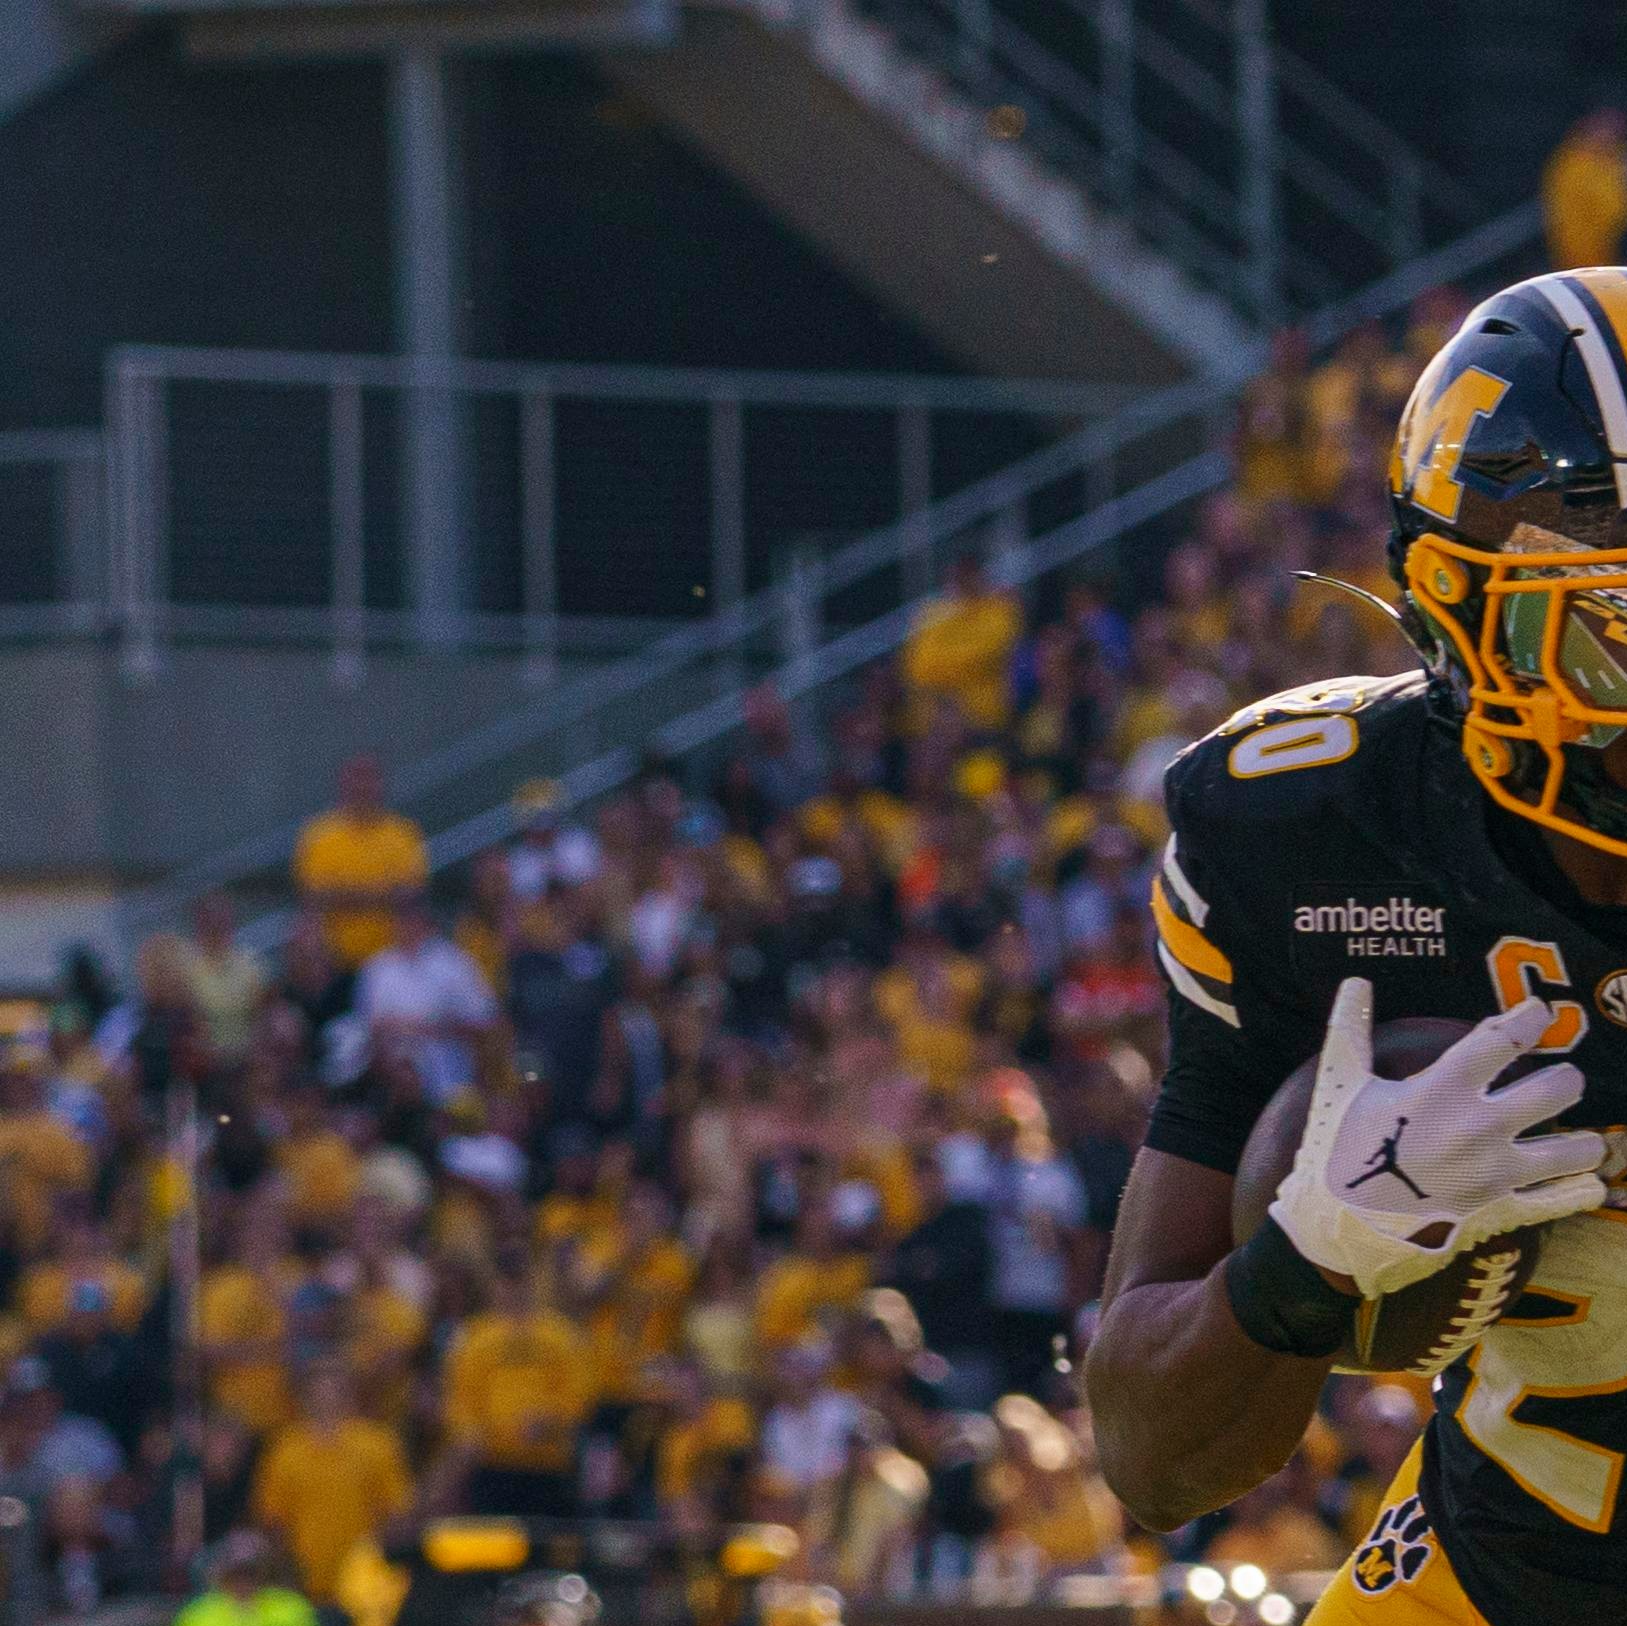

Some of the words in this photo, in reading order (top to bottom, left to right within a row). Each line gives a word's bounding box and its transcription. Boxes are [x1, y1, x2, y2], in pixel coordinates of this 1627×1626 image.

[1294, 897, 1446, 933] ambetter
[1346, 936, 1447, 957] HEALTH
[1486, 935, 1590, 1054] C
